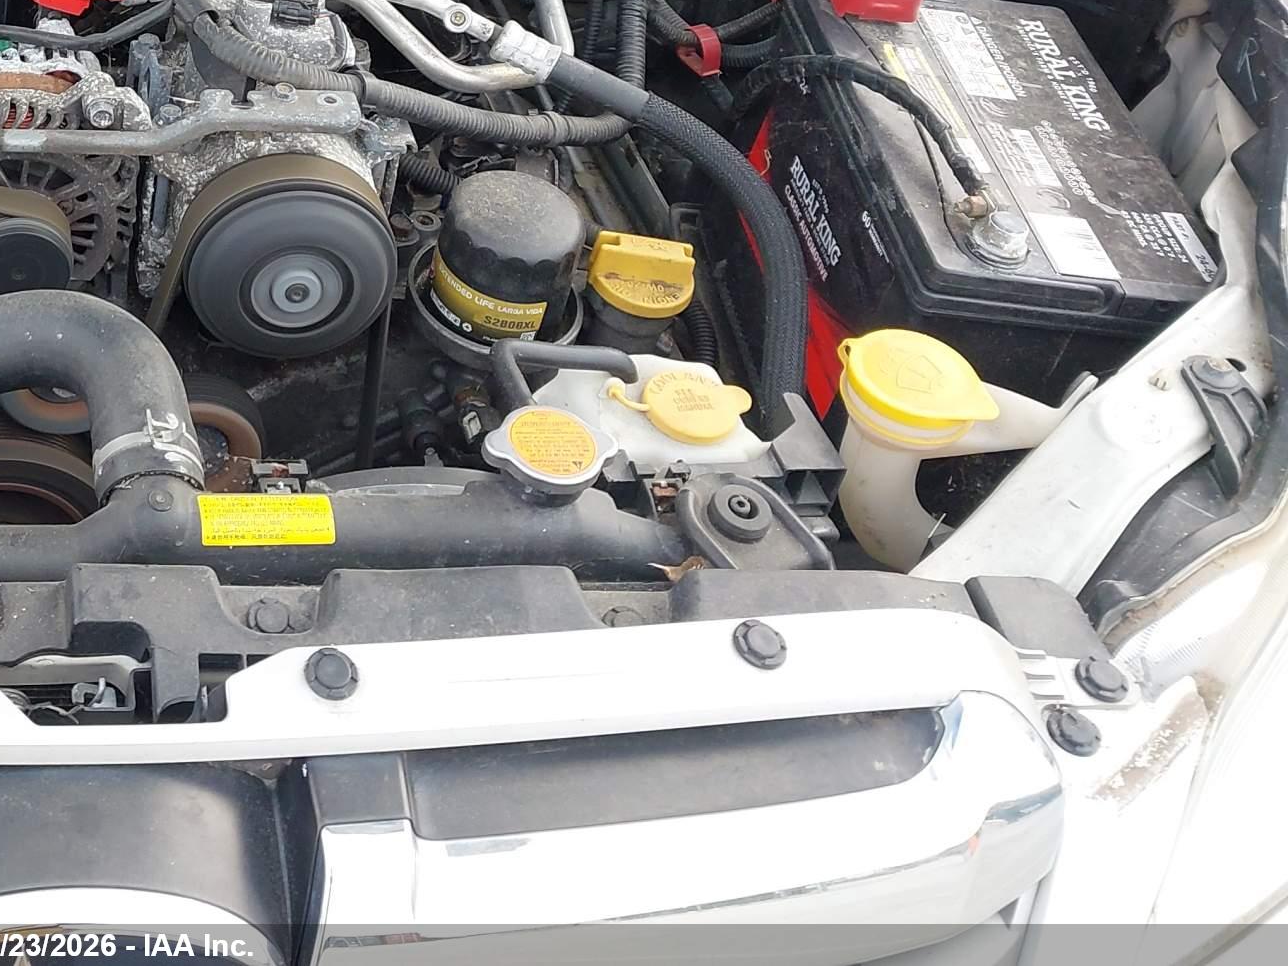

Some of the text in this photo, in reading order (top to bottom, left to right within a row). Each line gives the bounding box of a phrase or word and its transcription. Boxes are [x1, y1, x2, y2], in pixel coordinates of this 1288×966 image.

[1018, 18, 1076, 80] RURAL
[1060, 83, 1111, 131] KING
[784, 184, 829, 282] CLASSIC AUTOMOTIVE
[790, 155, 842, 267] RURAL KING
[862, 210, 872, 228] 60
[1152, 214, 1172, 237] GROUP
[474, 296, 495, 310] LIFE
[526, 307, 543, 315] VIDA
